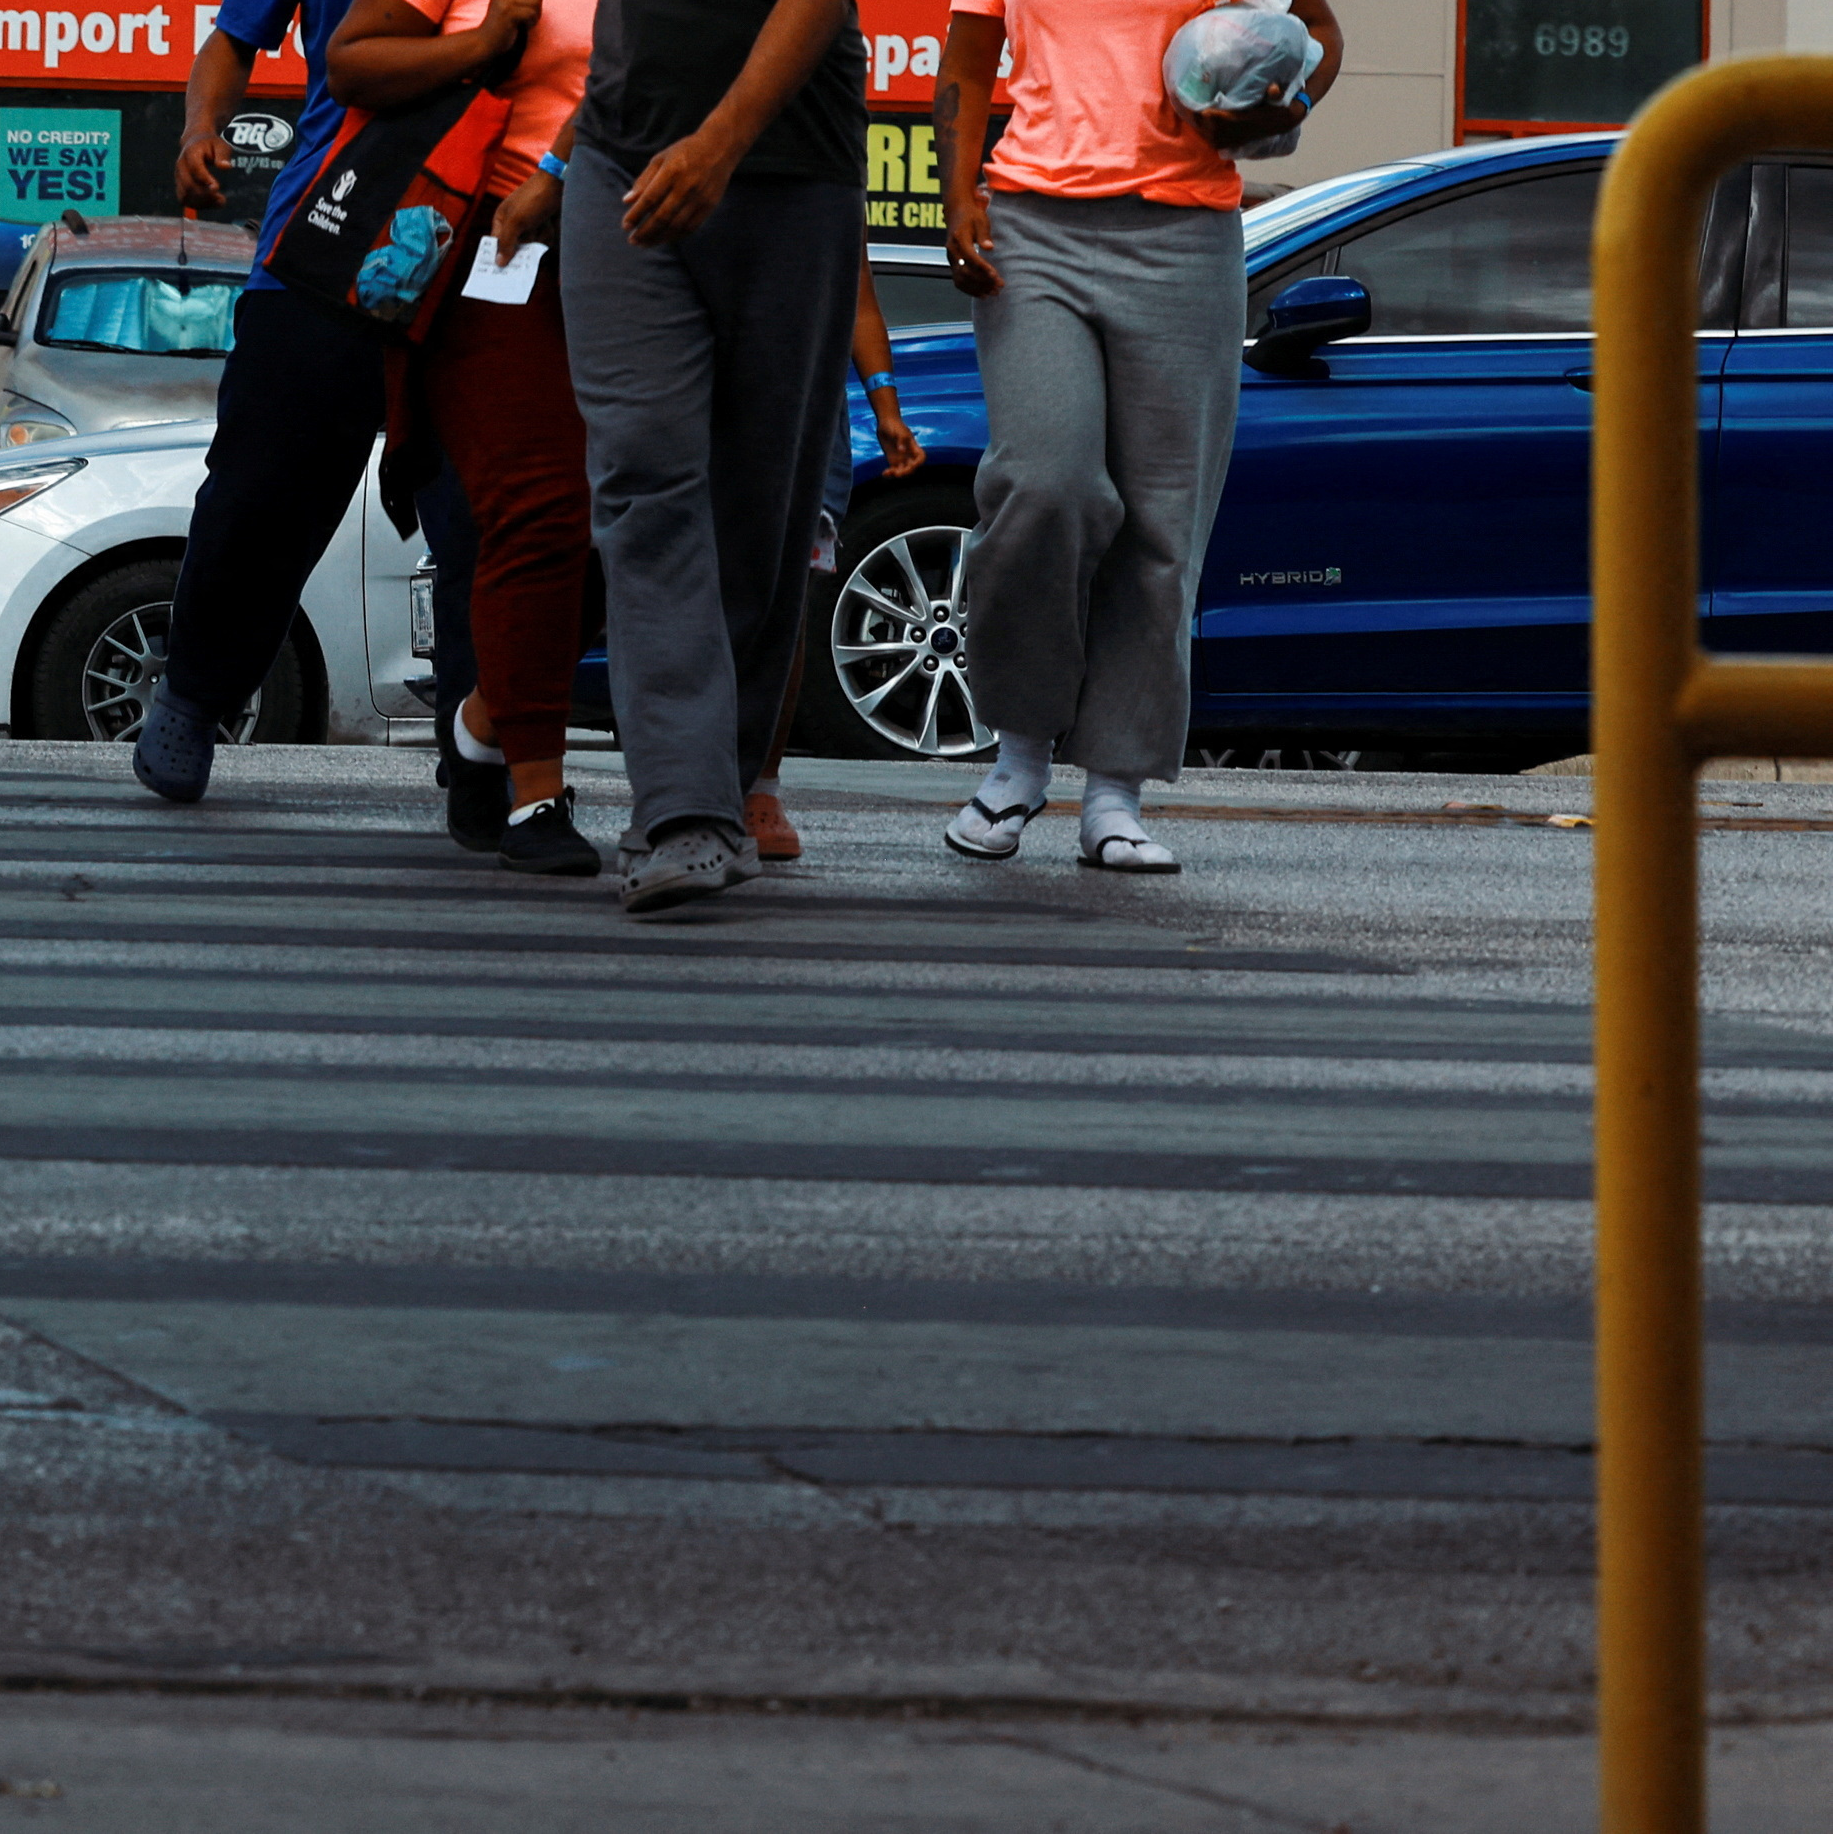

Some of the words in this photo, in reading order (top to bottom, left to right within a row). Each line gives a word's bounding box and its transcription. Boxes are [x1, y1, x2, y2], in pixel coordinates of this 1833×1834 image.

[1535, 23, 1630, 58] 6989
[7, 130, 32, 144] NO
[38, 130, 110, 145] CREDIT?
[7, 147, 50, 166] WE
[58, 148, 109, 167] SAY
[7, 168, 106, 201] YES!
[1240, 571, 1324, 585] HYBRID
